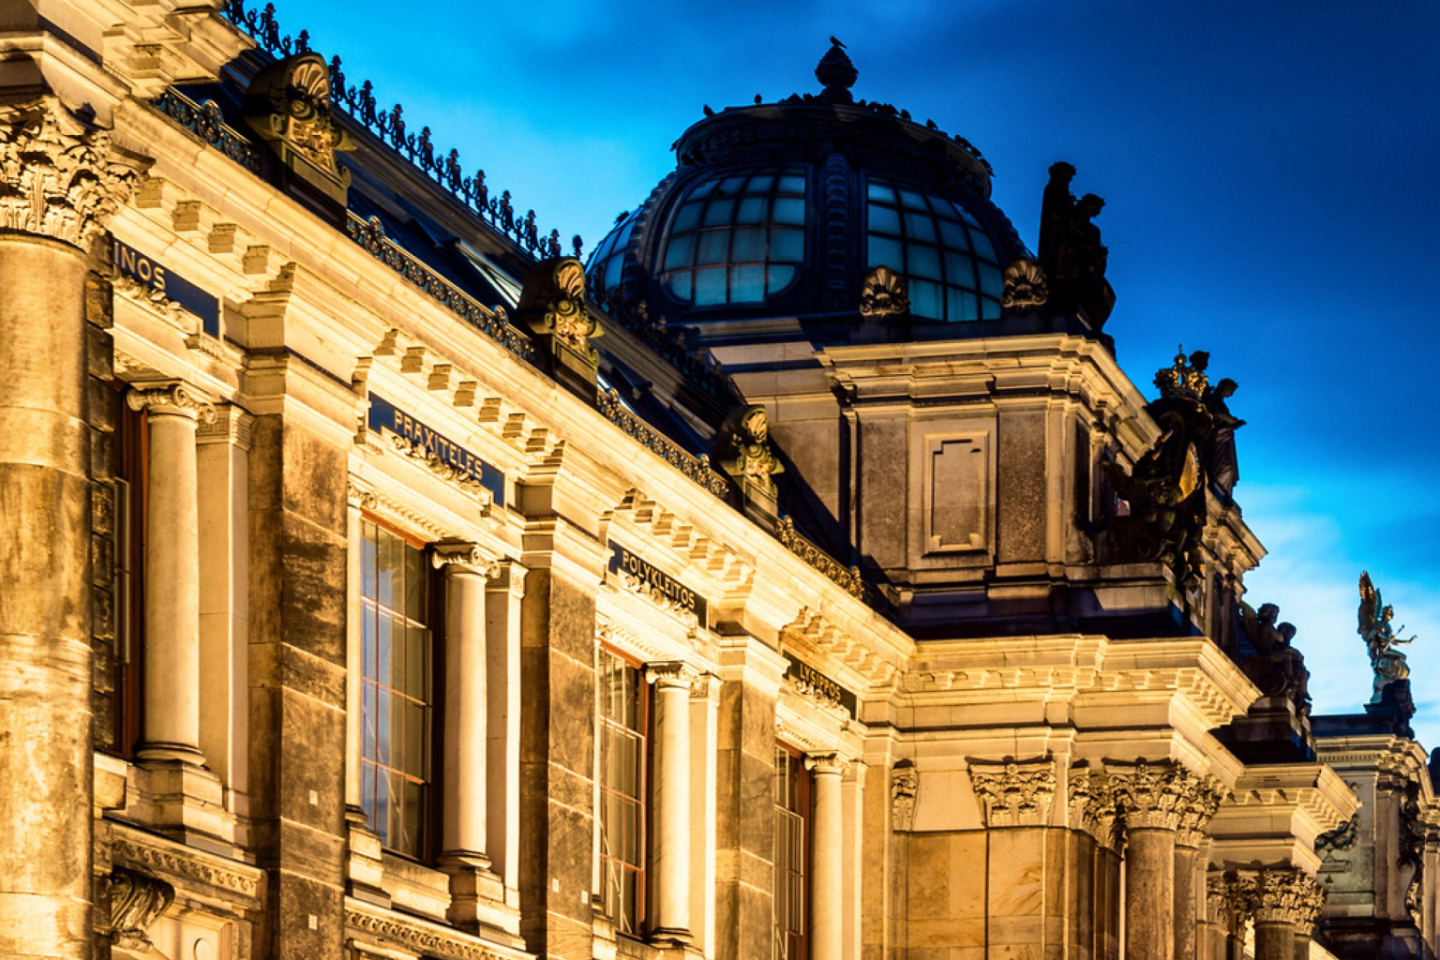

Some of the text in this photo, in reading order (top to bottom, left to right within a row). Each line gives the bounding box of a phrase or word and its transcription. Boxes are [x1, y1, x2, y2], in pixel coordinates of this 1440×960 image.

[394, 409, 483, 480] PRAXITELES
[622, 550, 695, 610] POLYKLEITOS
[800, 662, 841, 701] LYSIPPOS
